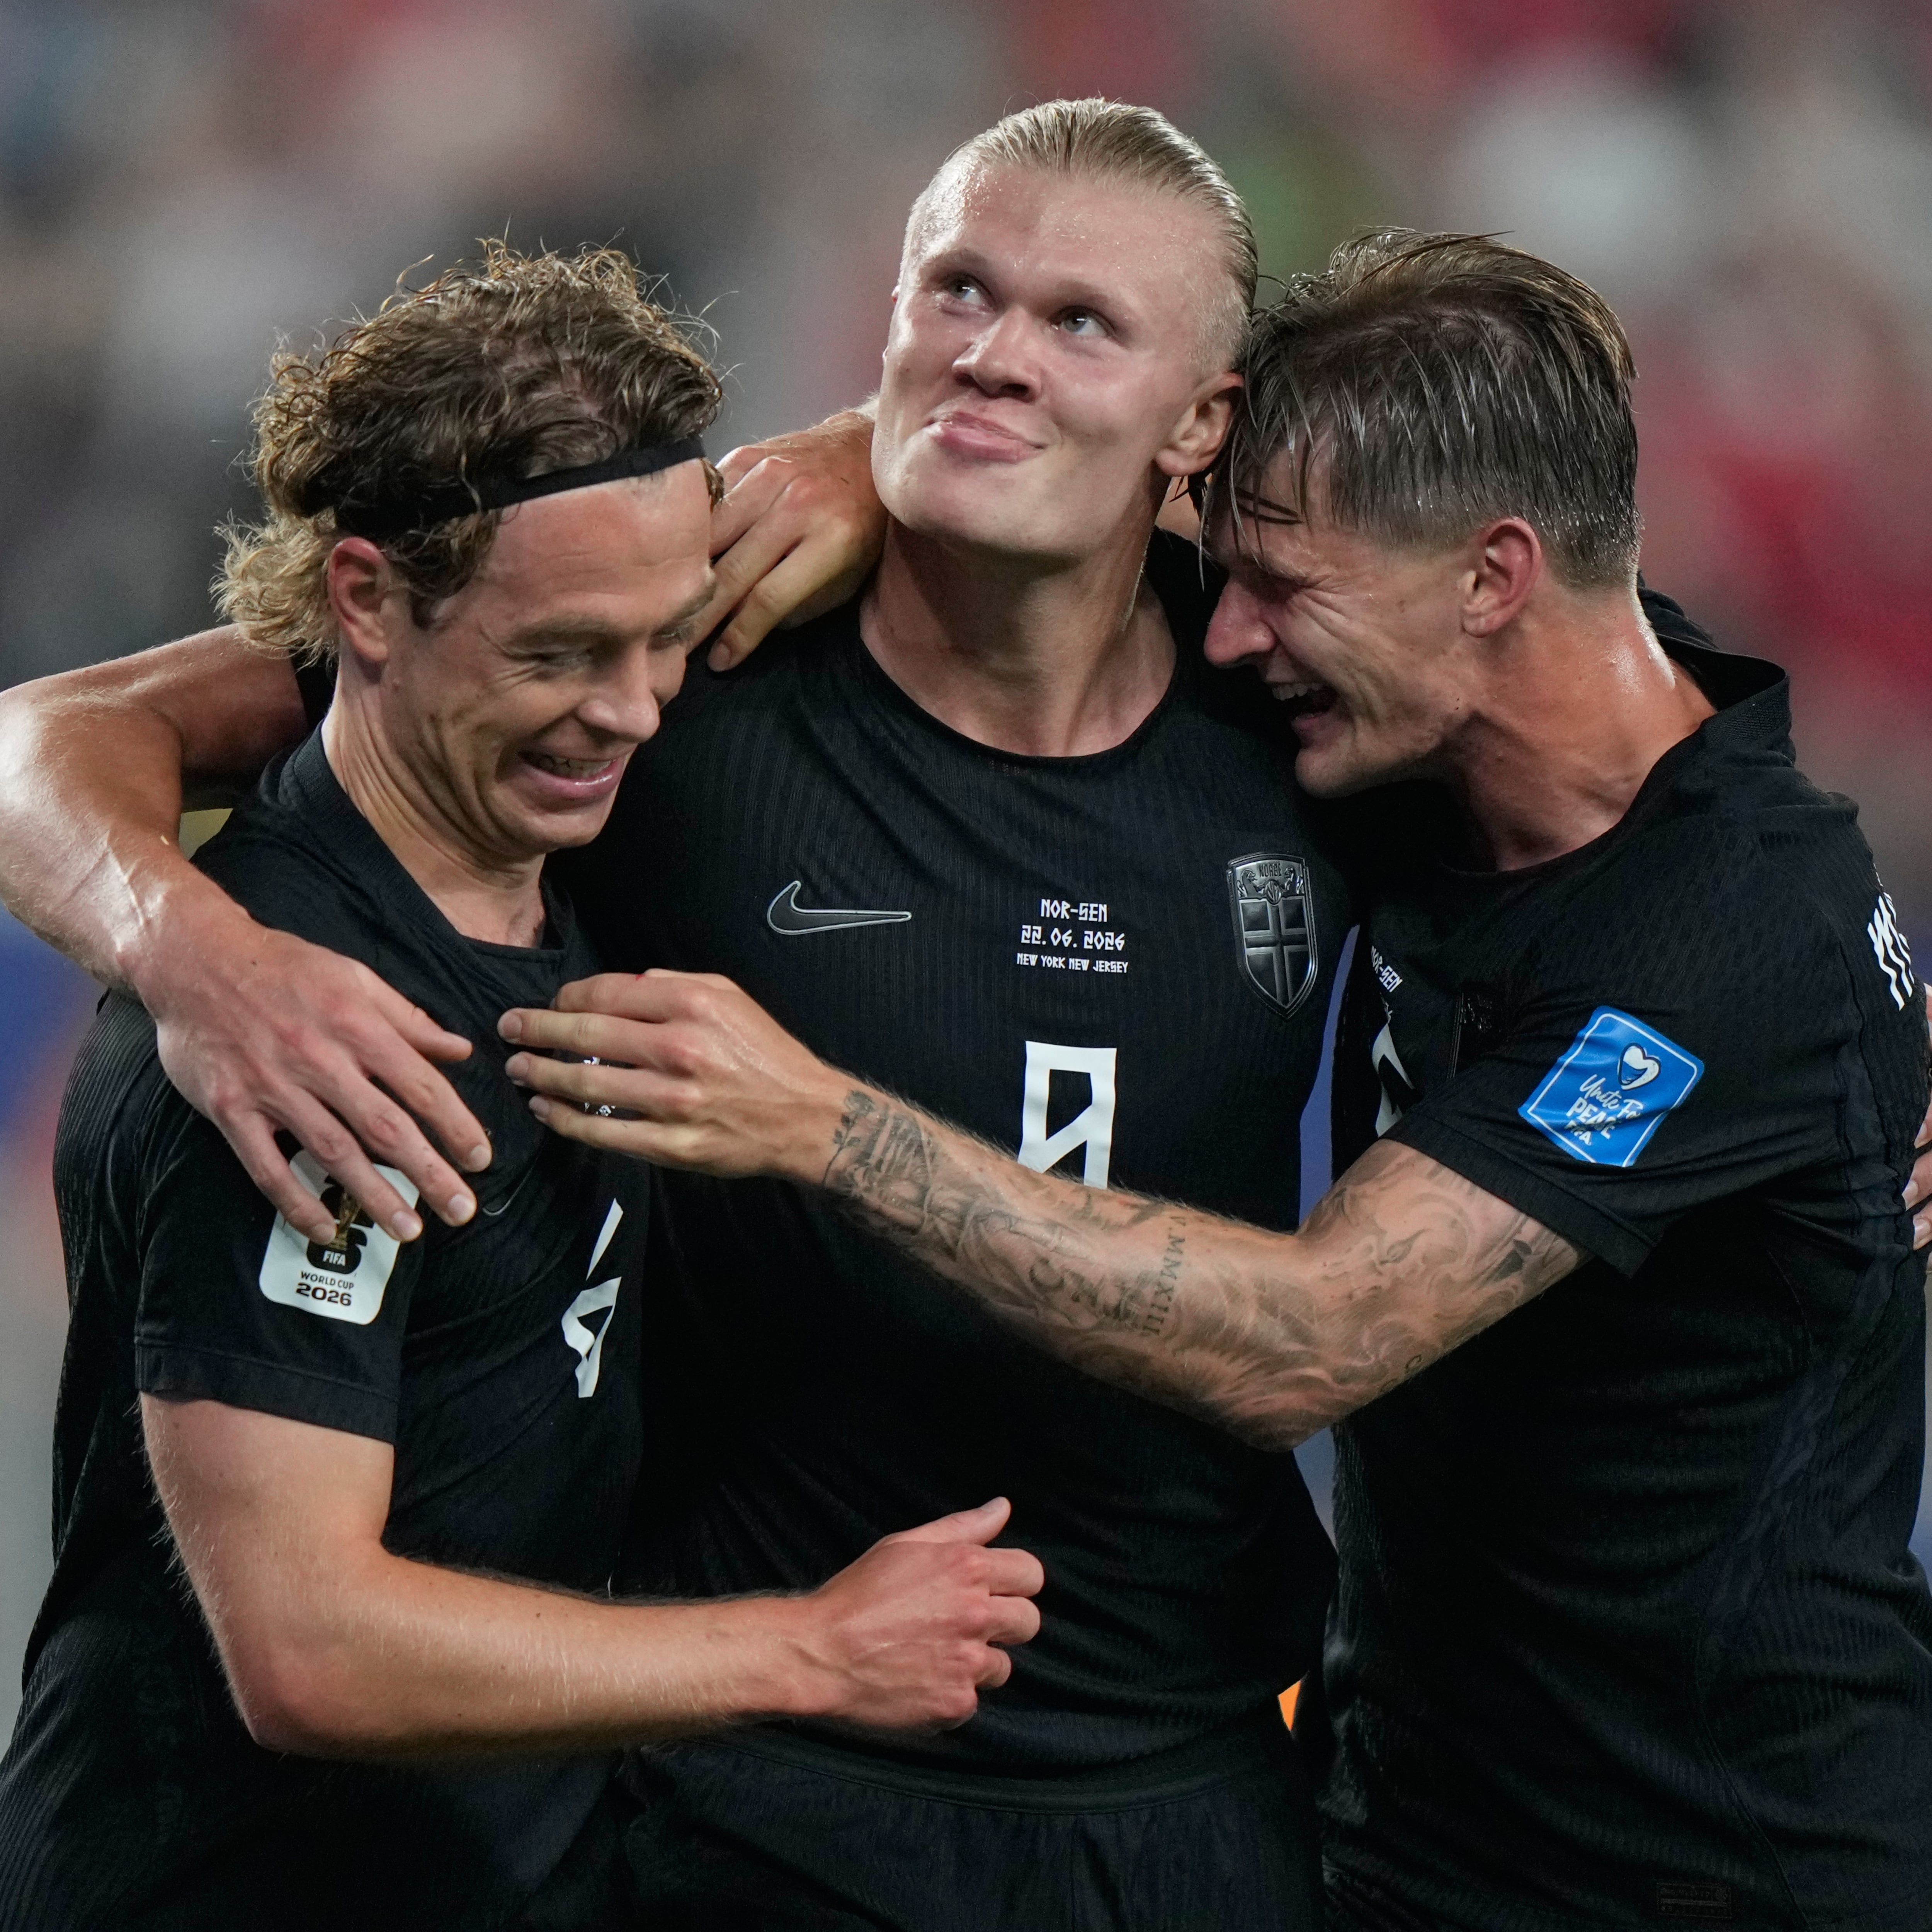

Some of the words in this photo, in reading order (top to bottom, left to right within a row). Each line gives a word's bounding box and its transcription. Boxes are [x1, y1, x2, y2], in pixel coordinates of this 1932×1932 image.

[1259, 862, 1282, 877] NORGE
[1041, 899, 1107, 922] NOR-SEN
[1017, 953, 1038, 966] NEW
[1041, 955, 1066, 969] YORK
[1069, 958, 1090, 971] NEW
[1093, 960, 1128, 973] JERSEY
[1579, 1074, 1622, 1109] Unite
[322, 1249, 346, 1267] FIFA
[300, 1271, 335, 1286] WORLD
[337, 1280, 354, 1290] CUP
[296, 1283, 352, 1306] 2026
